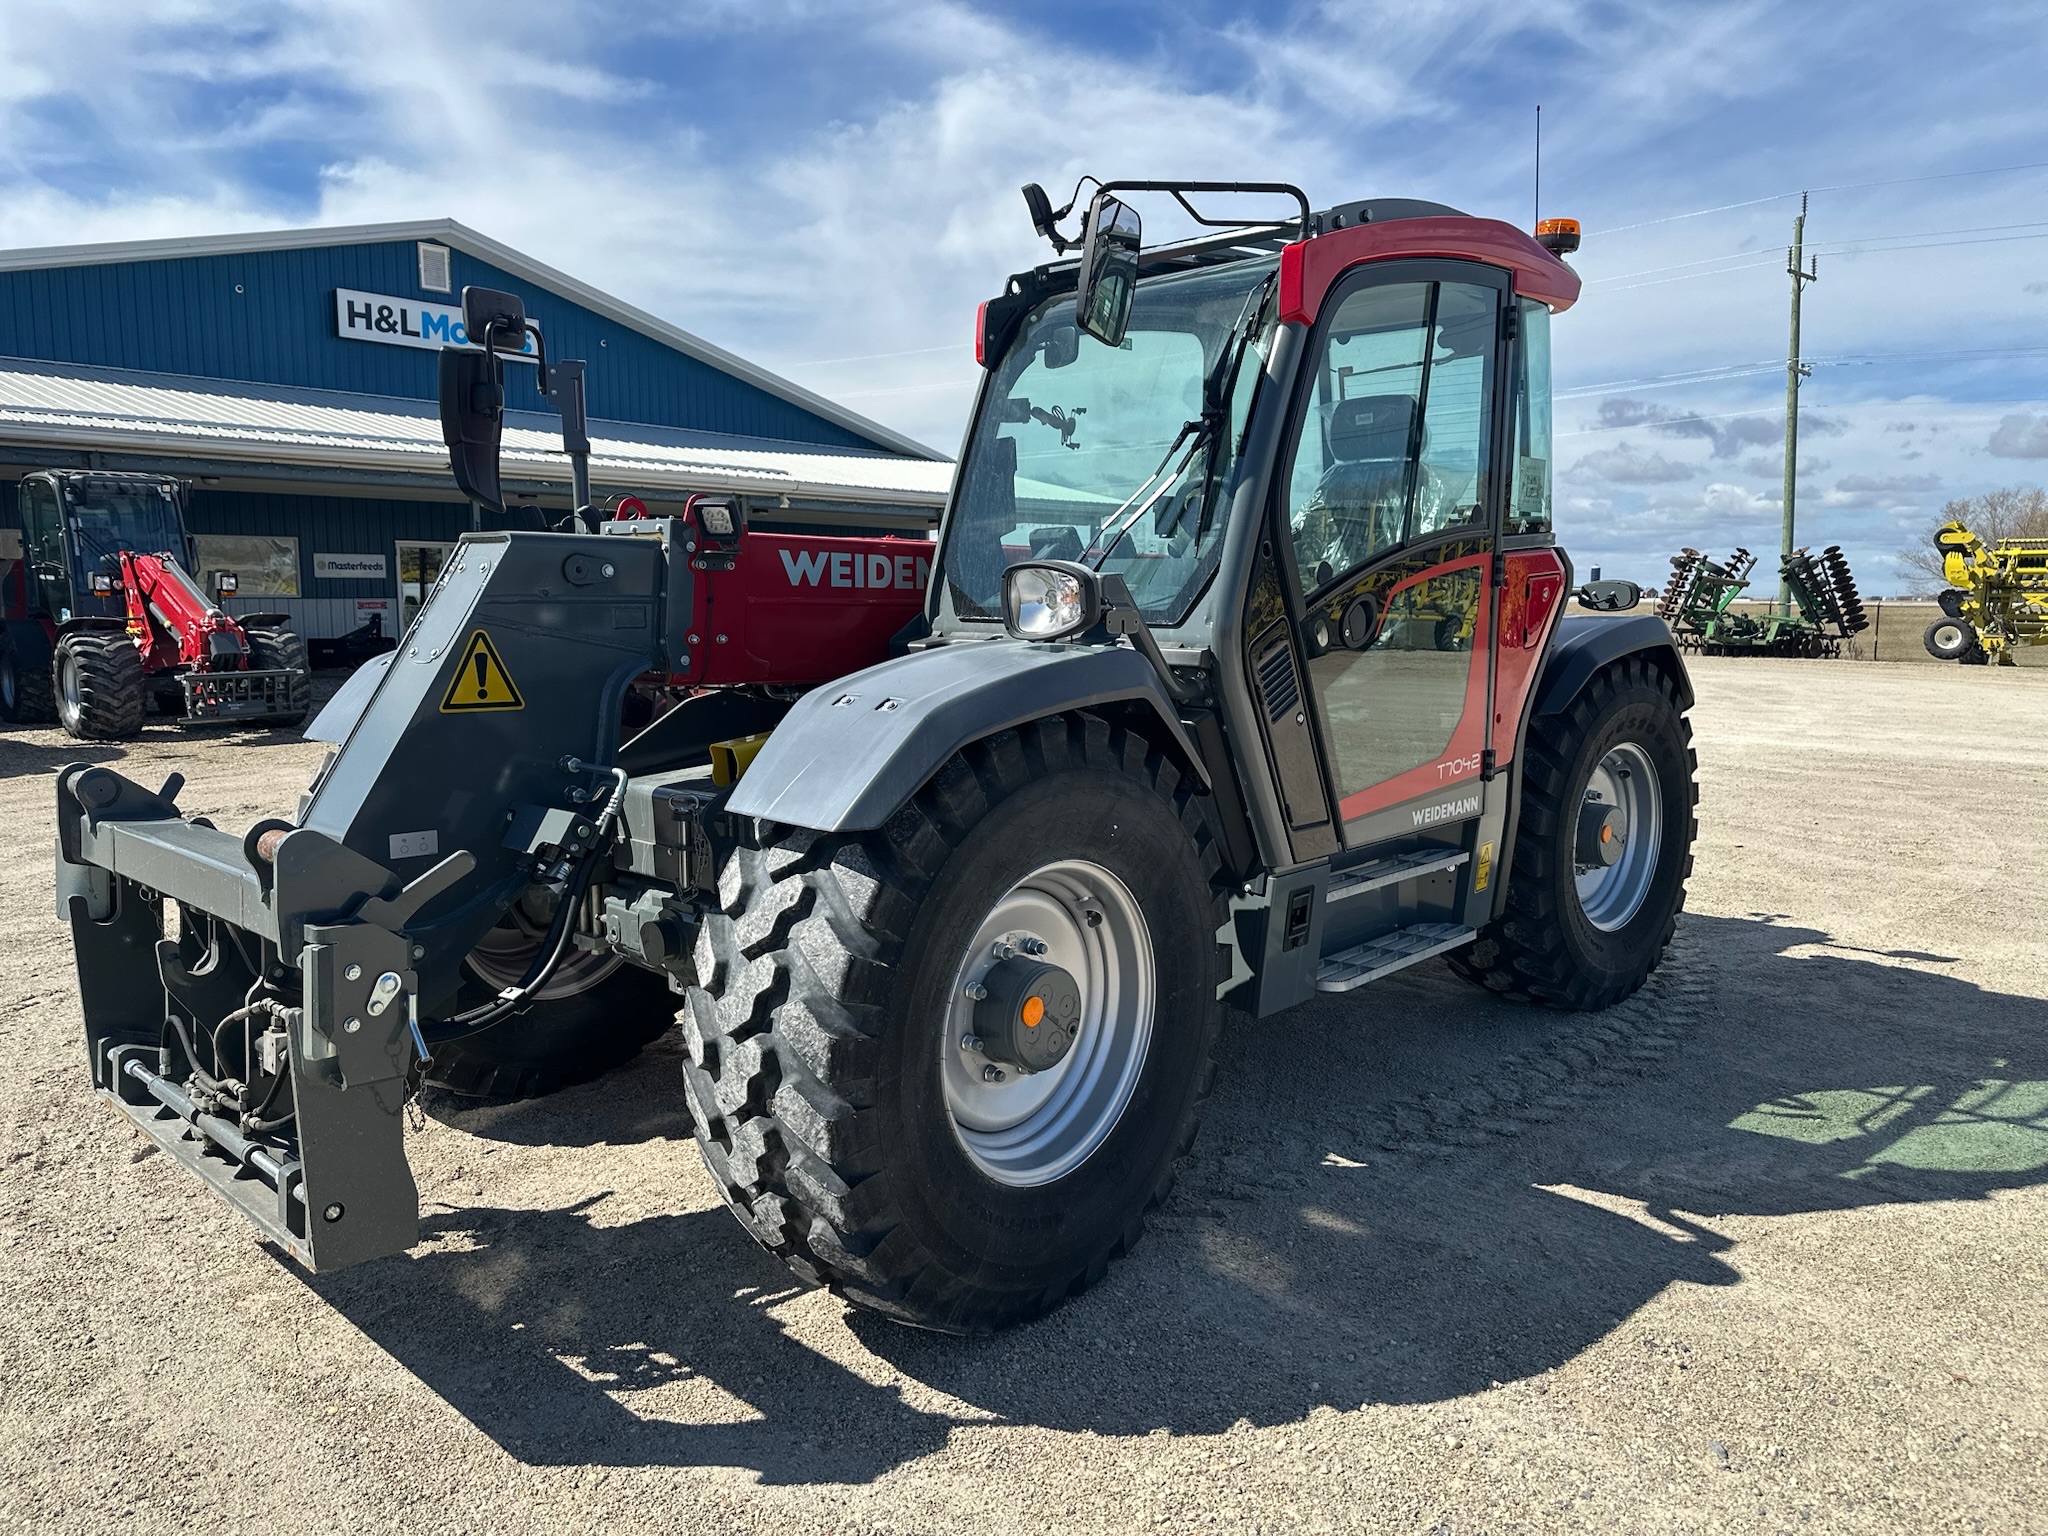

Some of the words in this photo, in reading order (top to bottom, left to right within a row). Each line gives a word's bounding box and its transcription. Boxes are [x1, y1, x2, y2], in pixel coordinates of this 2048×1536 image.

[328, 561, 384, 571] Masterfeeds
[1437, 753, 1480, 780] T7042
[1412, 796, 1479, 826] WEIDEMANN
